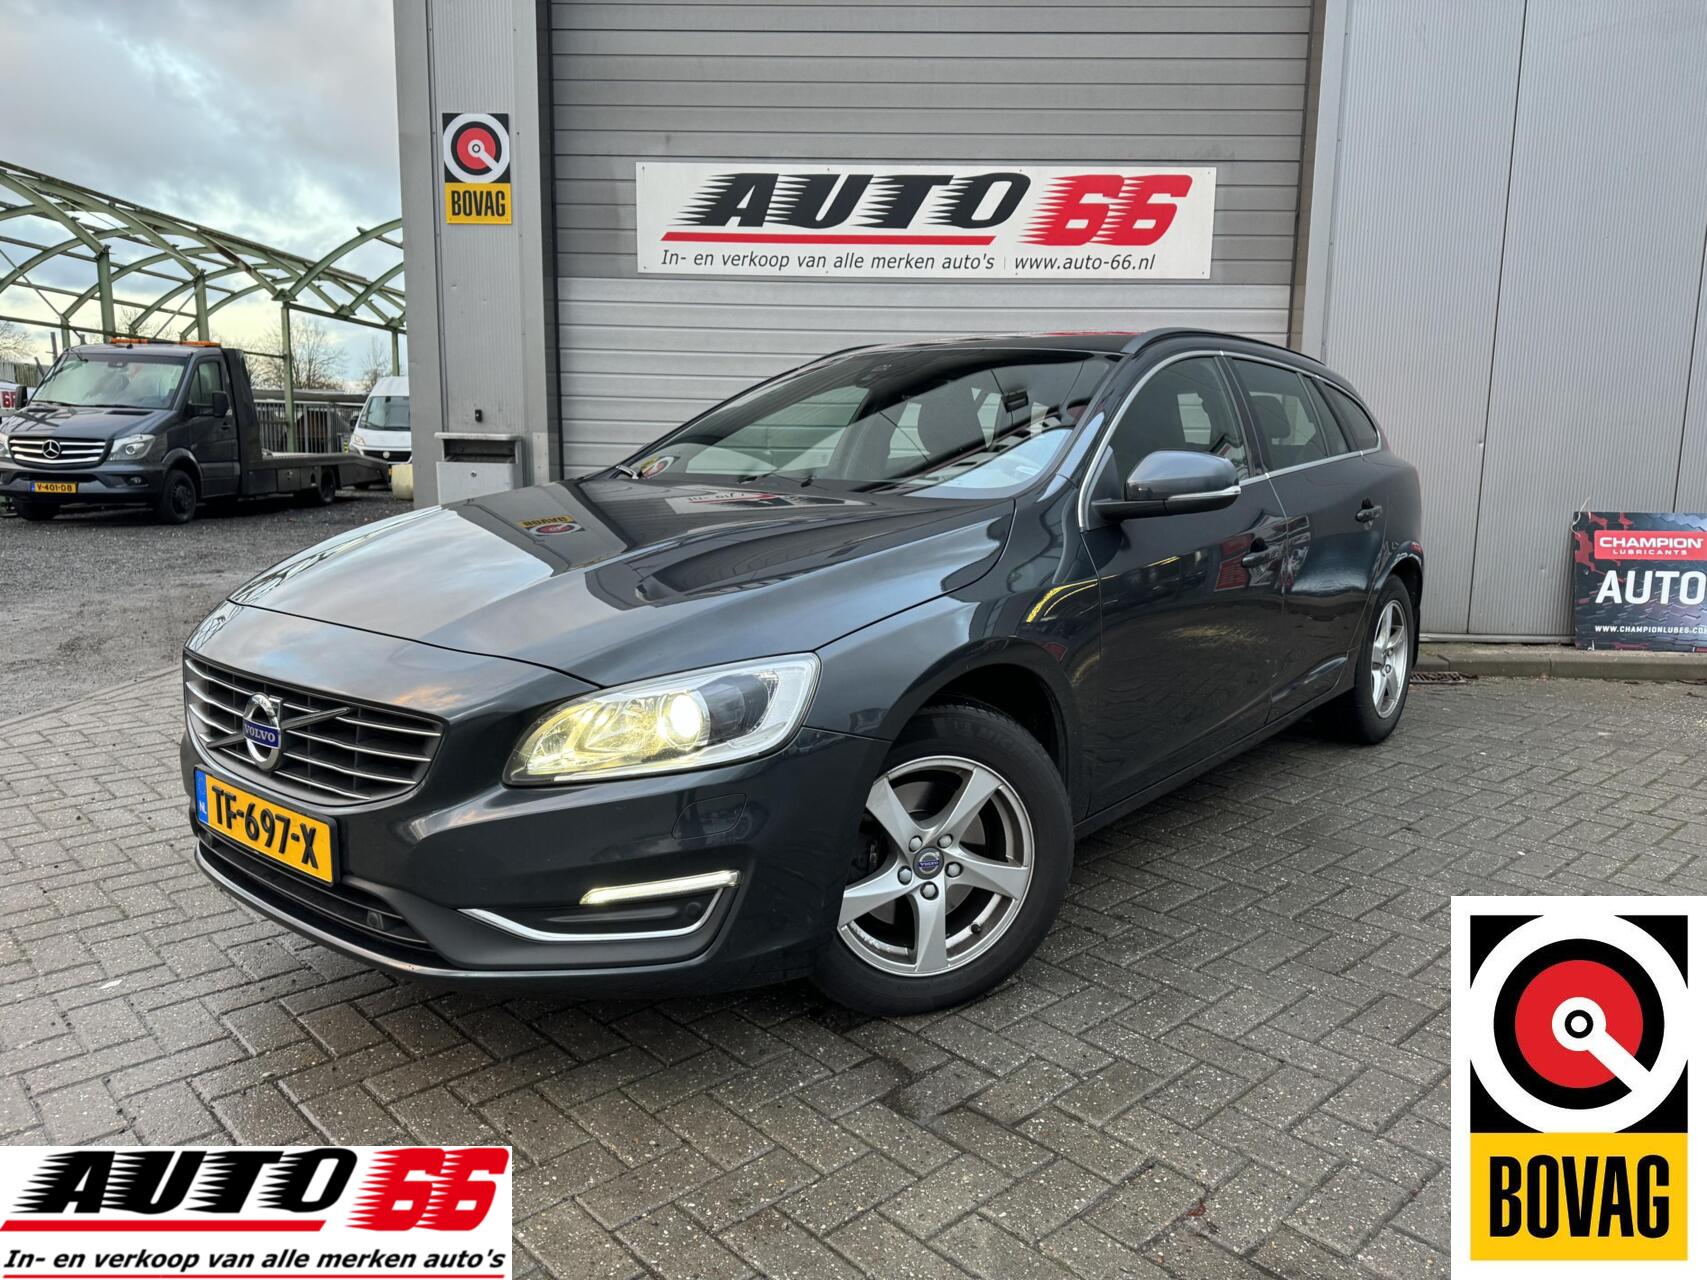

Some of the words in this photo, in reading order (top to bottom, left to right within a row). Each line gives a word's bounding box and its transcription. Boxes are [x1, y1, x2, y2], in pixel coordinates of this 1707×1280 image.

[451, 190, 506, 217] BOVAG
[668, 172, 1031, 229] AUTO
[1016, 174, 1193, 246] 66
[661, 250, 686, 265] In-
[694, 254, 714, 266] en
[722, 251, 790, 271] verkoop
[798, 256, 827, 268] van
[833, 252, 864, 269] alle
[871, 253, 935, 269] merken
[941, 253, 995, 270] auto's
[1014, 254, 1156, 271] www.auto-66.nl
[1600, 537, 1703, 548] CHAMPION
[1595, 570, 1707, 605] AUTO
[244, 723, 276, 742] VOLVO
[212, 785, 319, 869] TF-697-X
